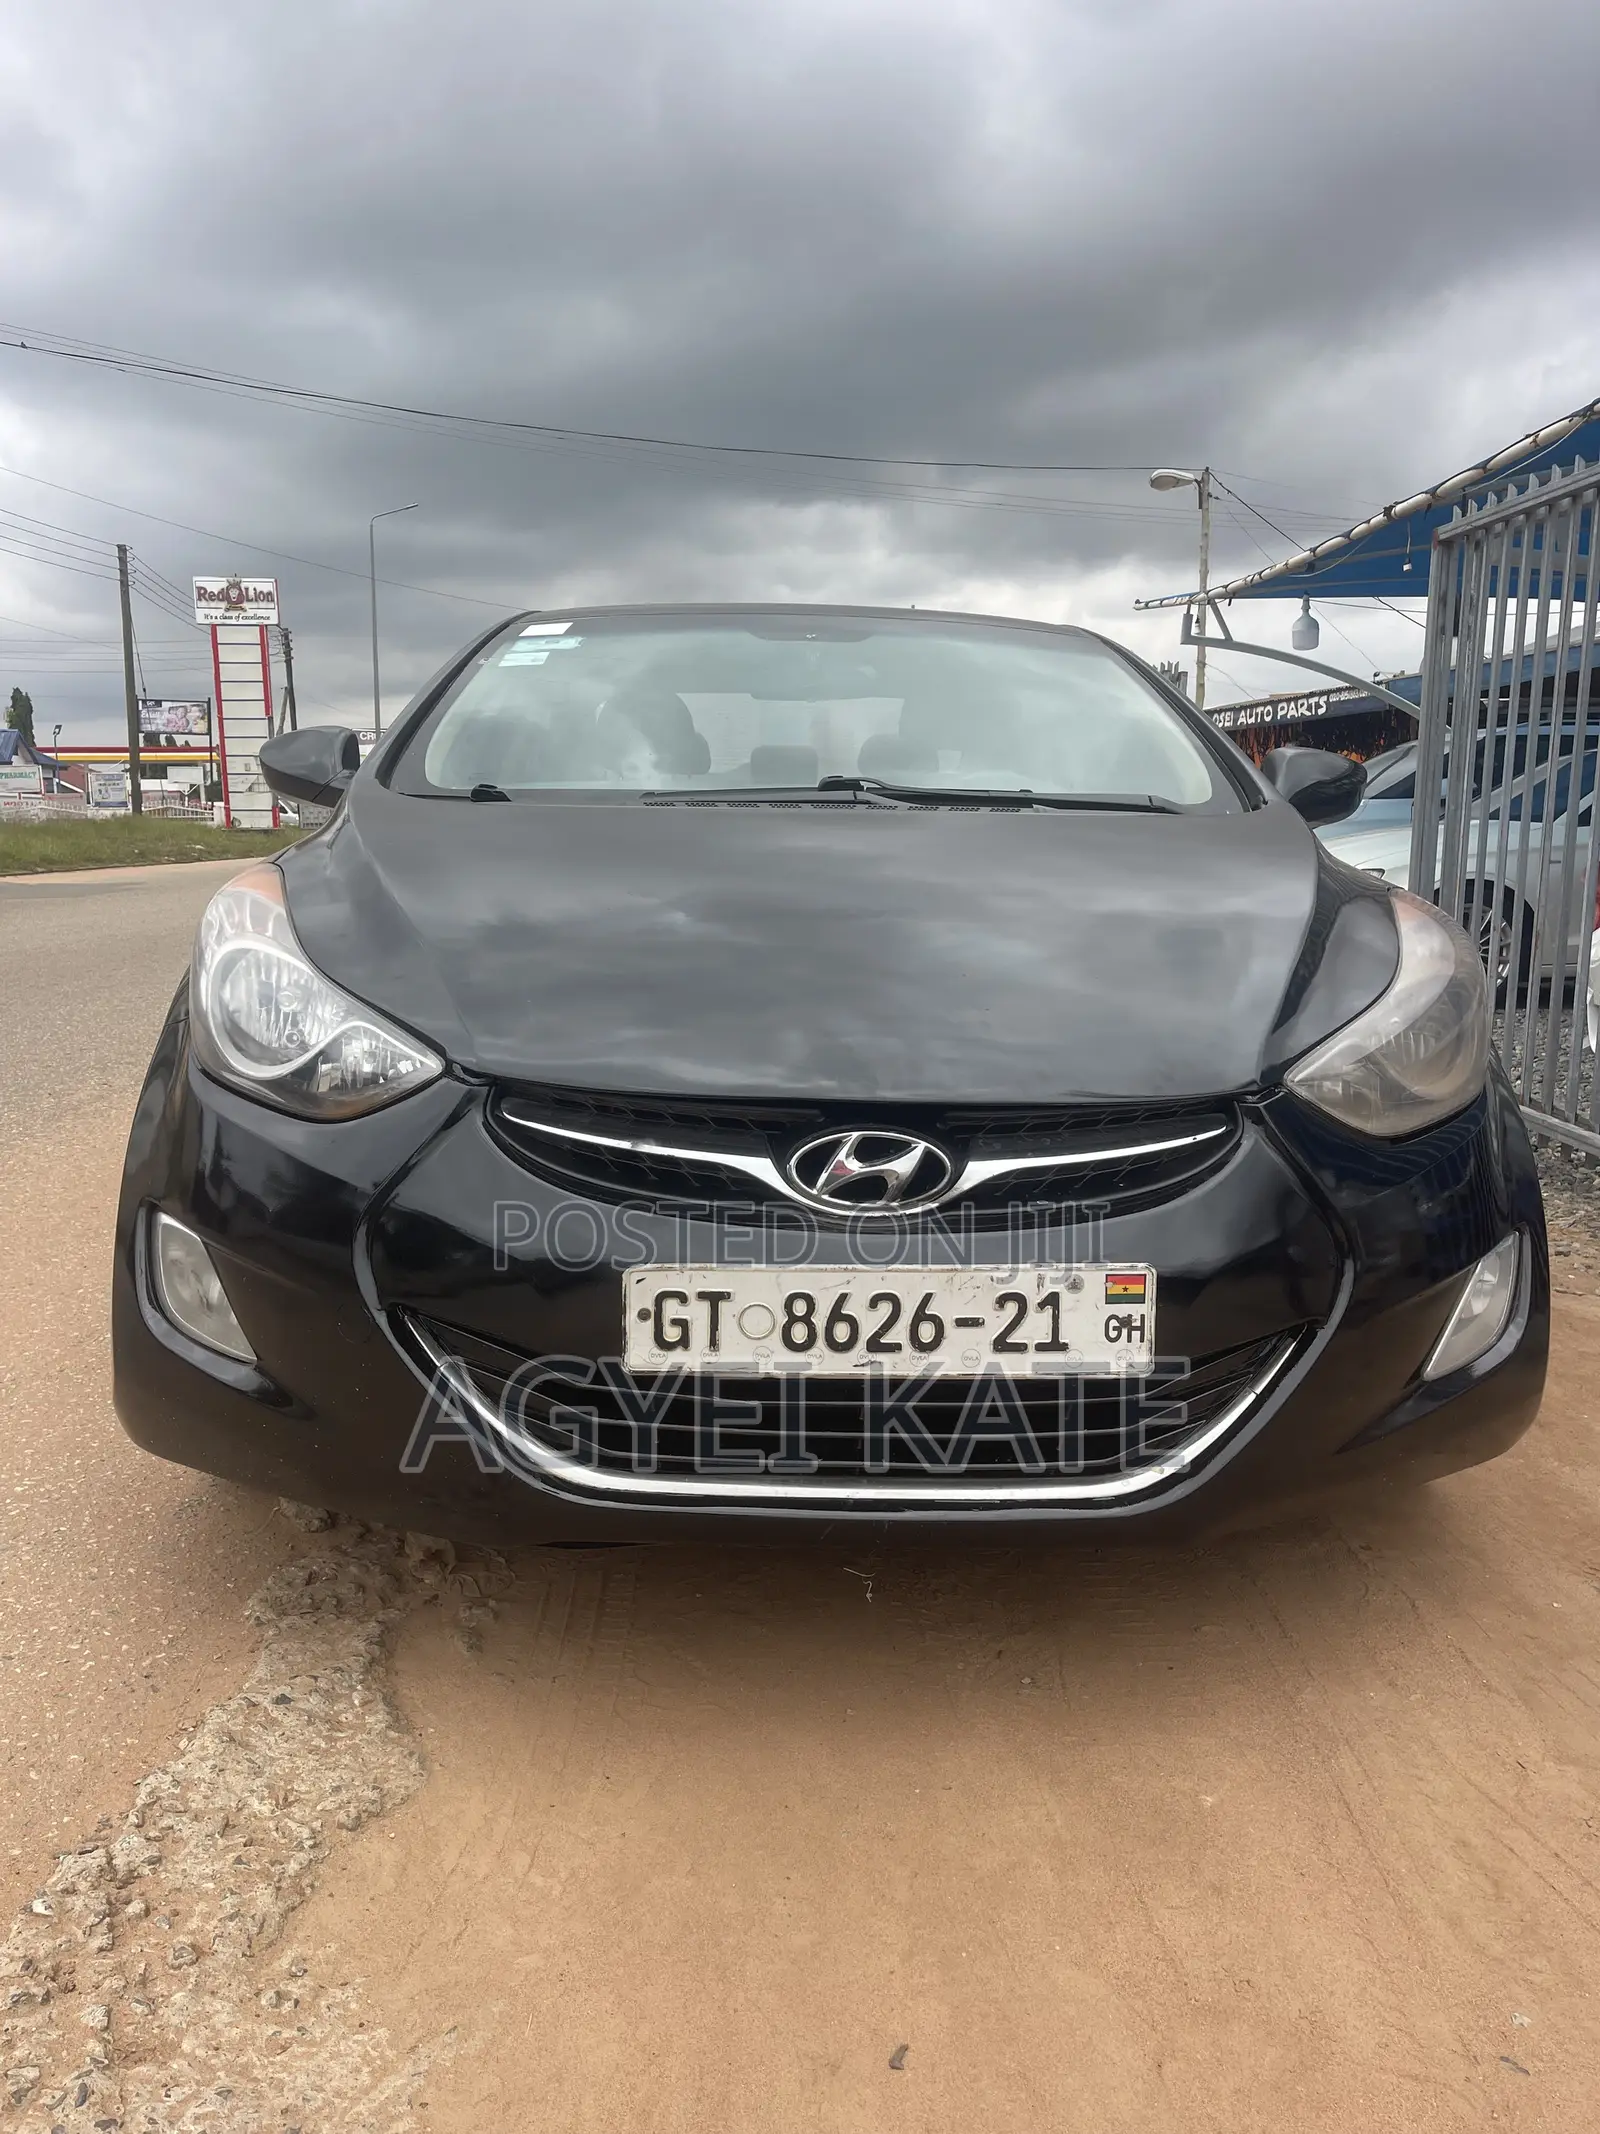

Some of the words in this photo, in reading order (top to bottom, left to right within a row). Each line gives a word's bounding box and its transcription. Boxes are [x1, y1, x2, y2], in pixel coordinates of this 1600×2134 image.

[195, 586, 226, 602] Red
[244, 587, 274, 602] Lion
[234, 613, 242, 622] of
[1212, 711, 1233, 728] OSEI
[1237, 705, 1273, 726] AUTO
[1277, 695, 1328, 720] PARTS
[653, 1290, 733, 1351] GT
[781, 1291, 1070, 1353] 8626-21
[1104, 1313, 1146, 1344] GH
